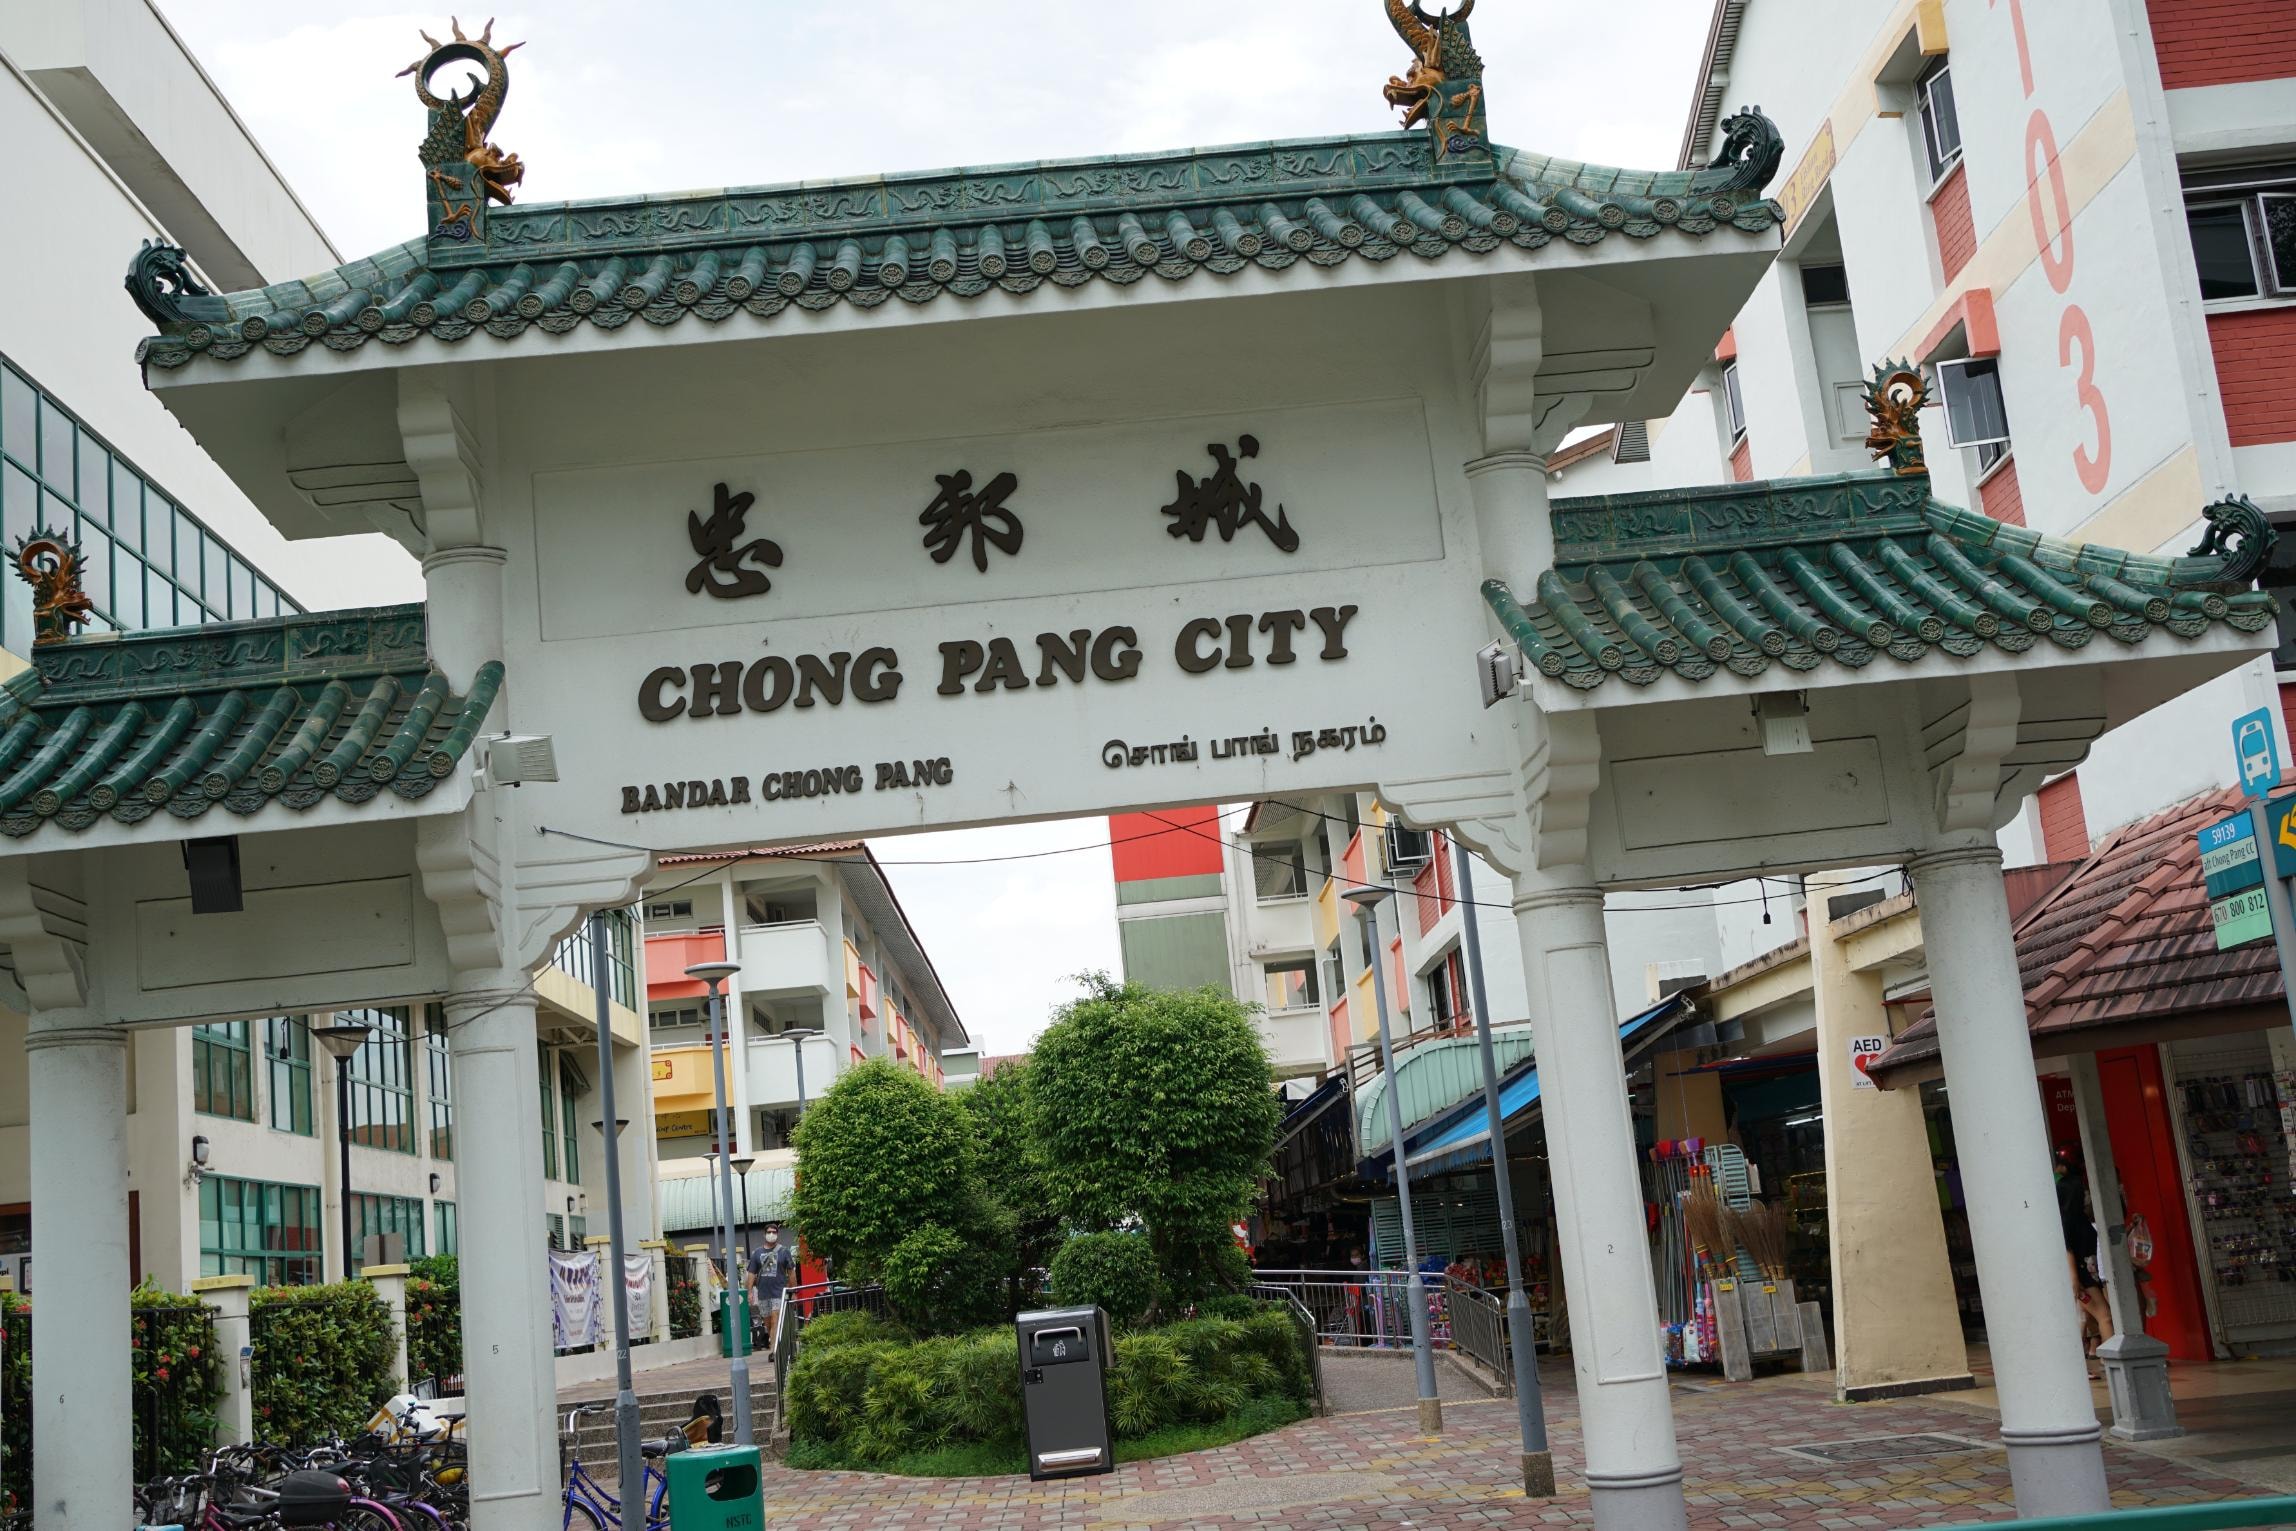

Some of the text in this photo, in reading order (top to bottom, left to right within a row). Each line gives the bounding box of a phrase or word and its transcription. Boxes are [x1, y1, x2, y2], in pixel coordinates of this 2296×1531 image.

[638, 604, 1359, 722] CHONG PANG CITY
[1210, 726, 1280, 759] பாங்
[1291, 715, 1387, 762] நகரம்
[621, 757, 953, 813] BANDAR CHONG PANG
[2211, 822, 2235, 845] 59139
[2212, 852, 2231, 868] Chong
[2230, 847, 2246, 861] Pang
[2245, 842, 2255, 854] CC
[2214, 893, 2265, 923] 670 800 812
[1853, 1039, 1882, 1052] AED
[1607, 1243, 1615, 1254] 2
[492, 1344, 500, 1354] 5
[59, 1394, 65, 1404] 6
